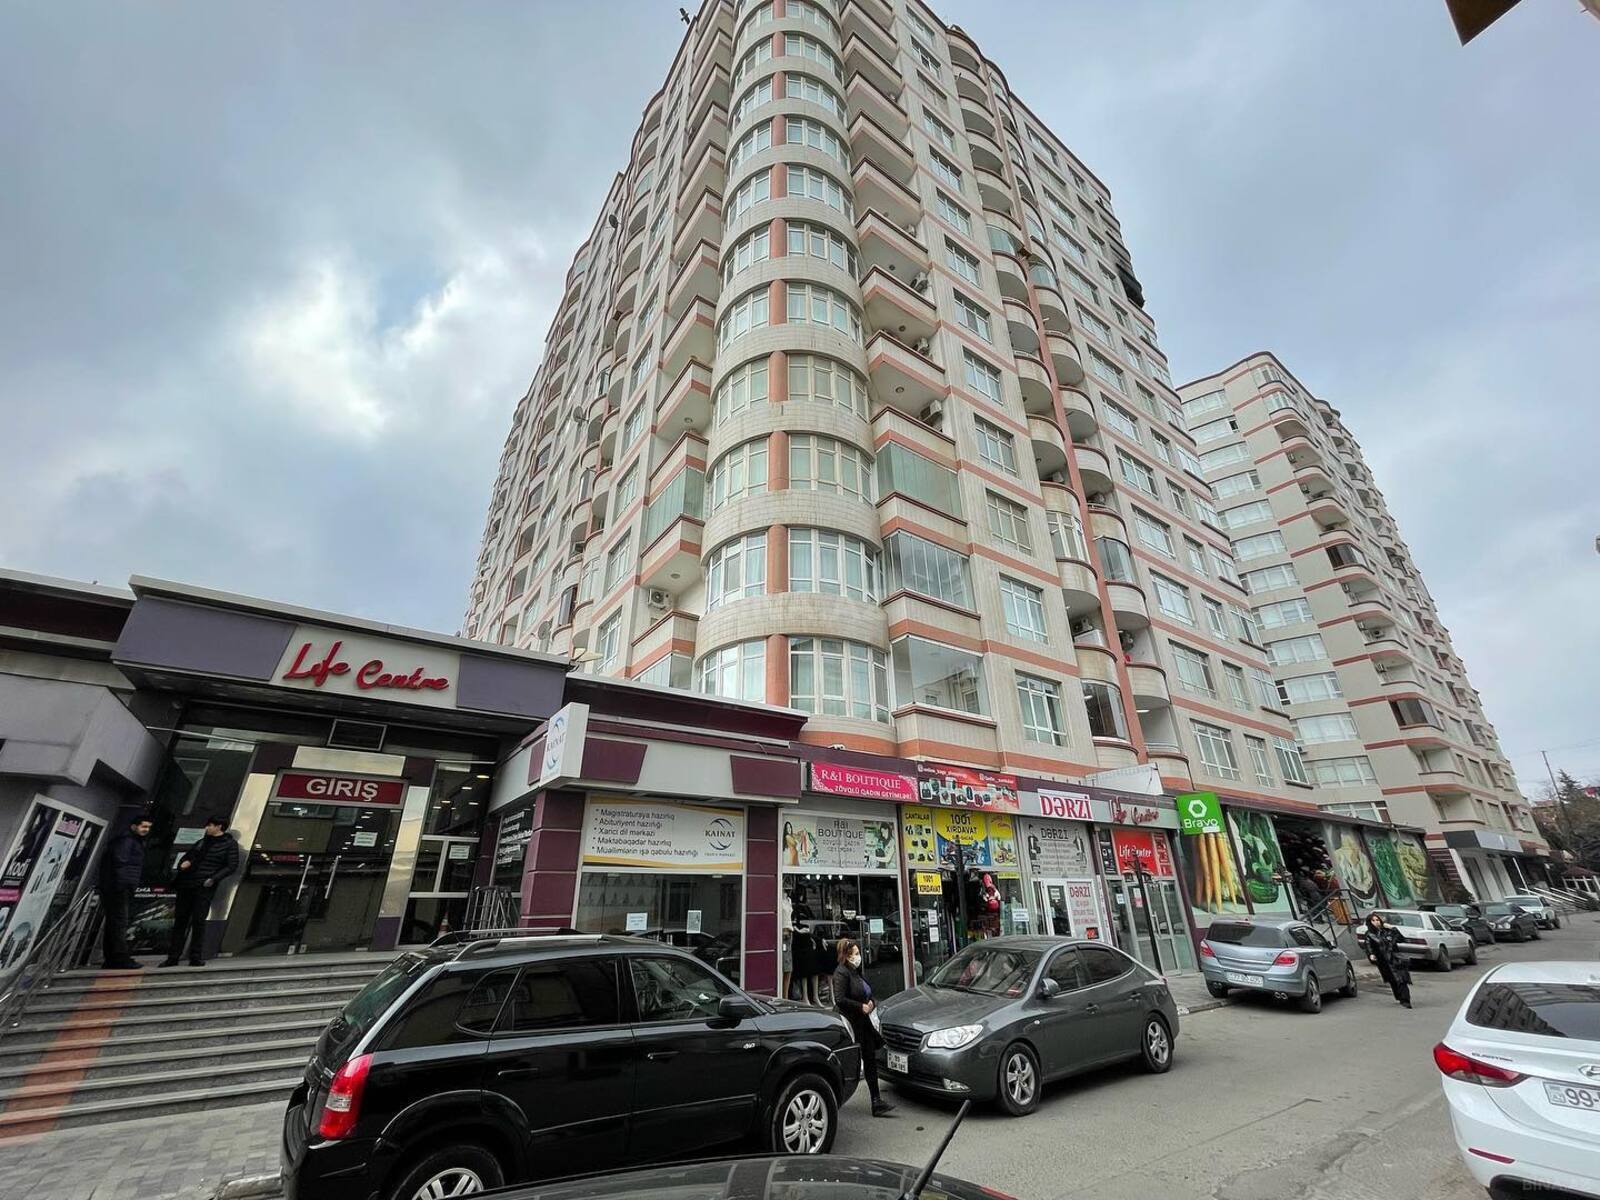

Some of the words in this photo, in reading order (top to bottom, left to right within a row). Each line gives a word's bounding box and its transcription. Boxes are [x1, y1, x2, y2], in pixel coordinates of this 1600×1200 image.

[282, 641, 351, 687] Life
[356, 660, 449, 690] Centre
[821, 770, 842, 781] R&I
[845, 772, 901, 790] BOUTIQUE
[1040, 795, 1093, 819] DƏRZİ
[950, 814, 971, 824] 1001
[1183, 819, 1219, 829] Bravo
